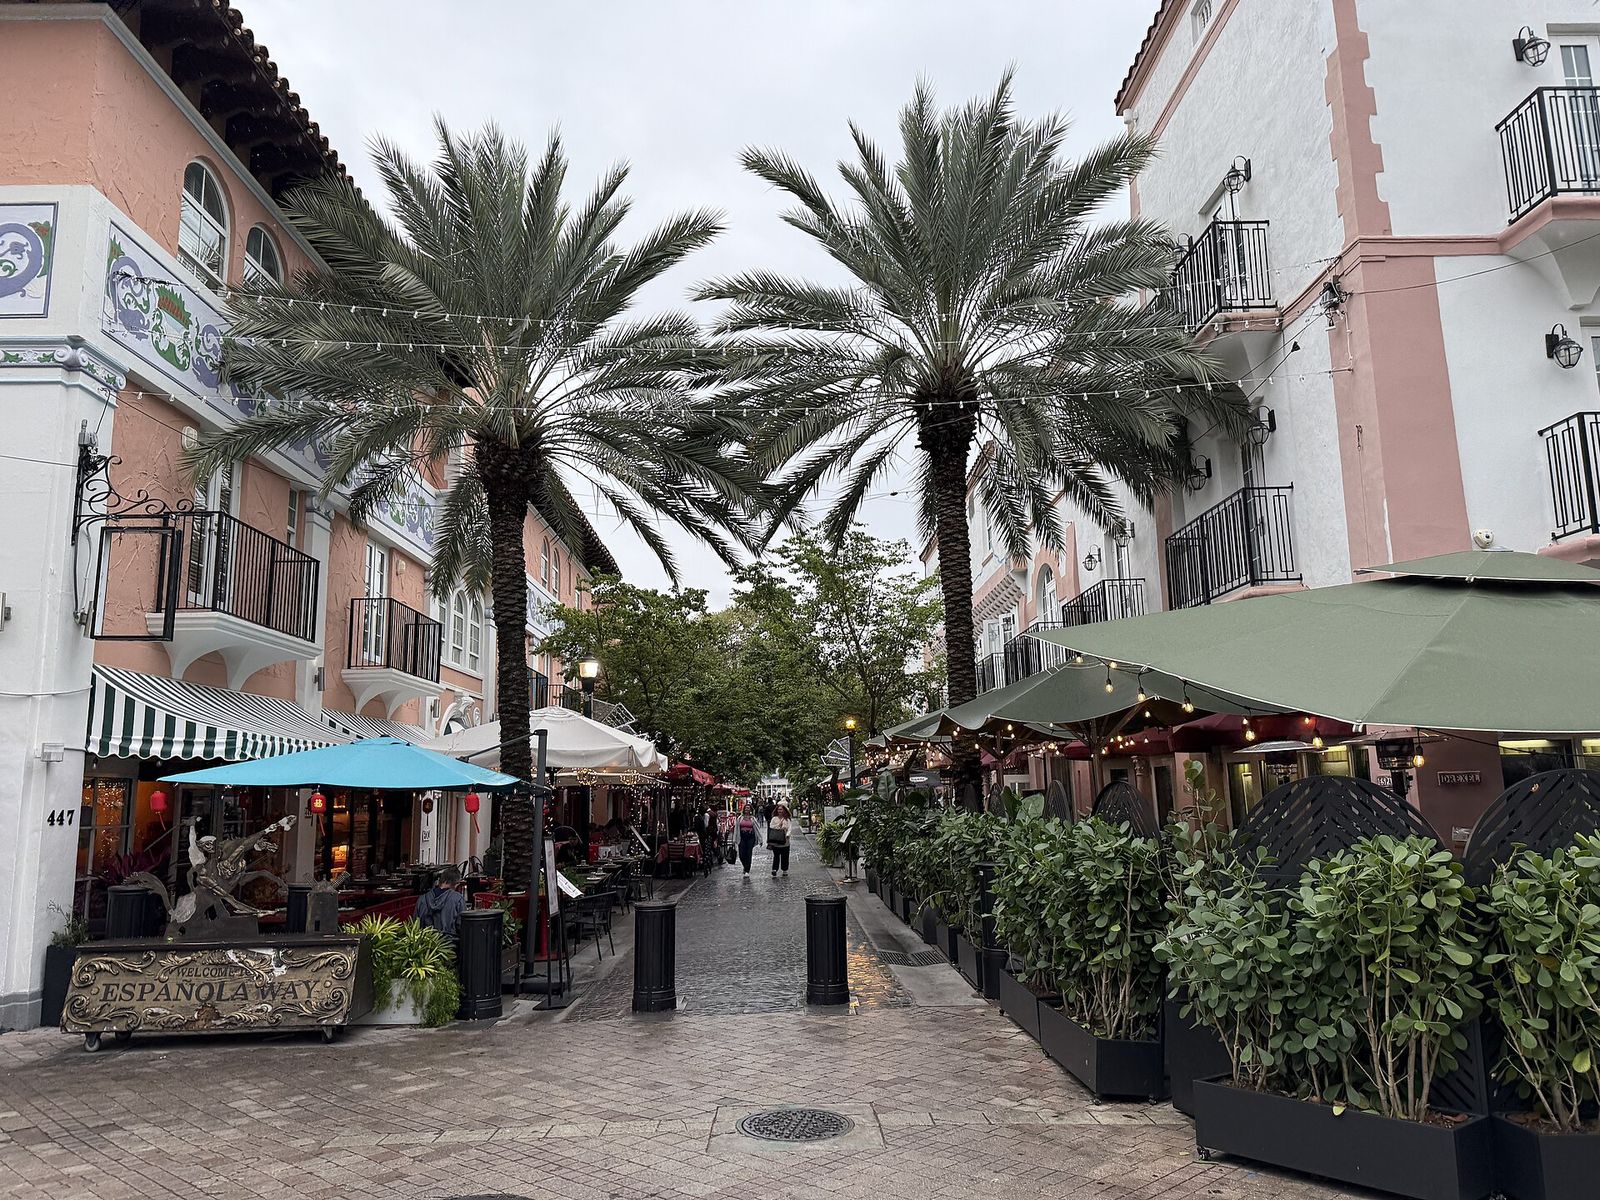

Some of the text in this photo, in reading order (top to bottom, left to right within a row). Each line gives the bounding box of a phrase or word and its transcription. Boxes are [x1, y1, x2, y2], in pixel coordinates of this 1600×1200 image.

[1440, 773, 1481, 784] DREXEL
[47, 809, 75, 827] 447
[176, 966, 236, 979] WELCOME
[99, 979, 321, 1002] ESPAÑOLA WAY
